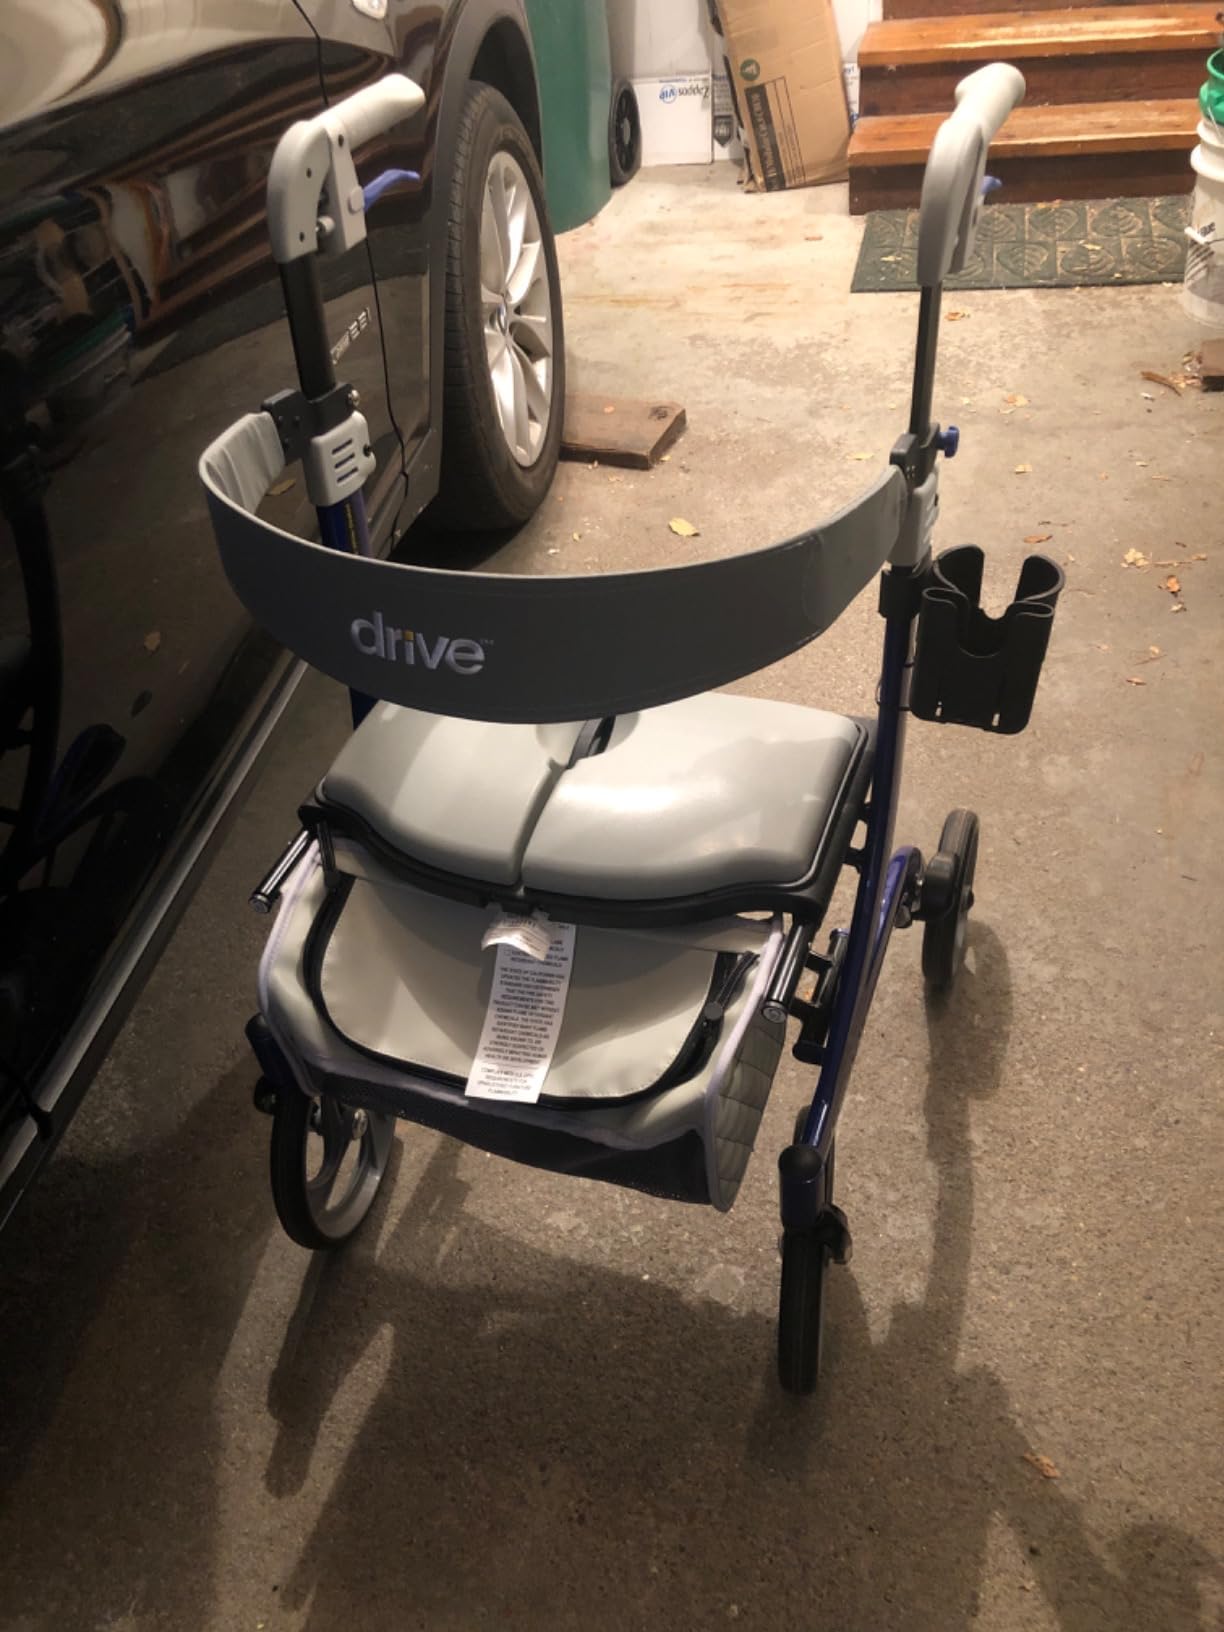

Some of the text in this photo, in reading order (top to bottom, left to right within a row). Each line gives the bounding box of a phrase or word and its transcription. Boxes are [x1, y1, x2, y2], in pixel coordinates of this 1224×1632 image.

[659, 84, 709, 100] Zappos VIP
[350, 610, 486, 675] drive
